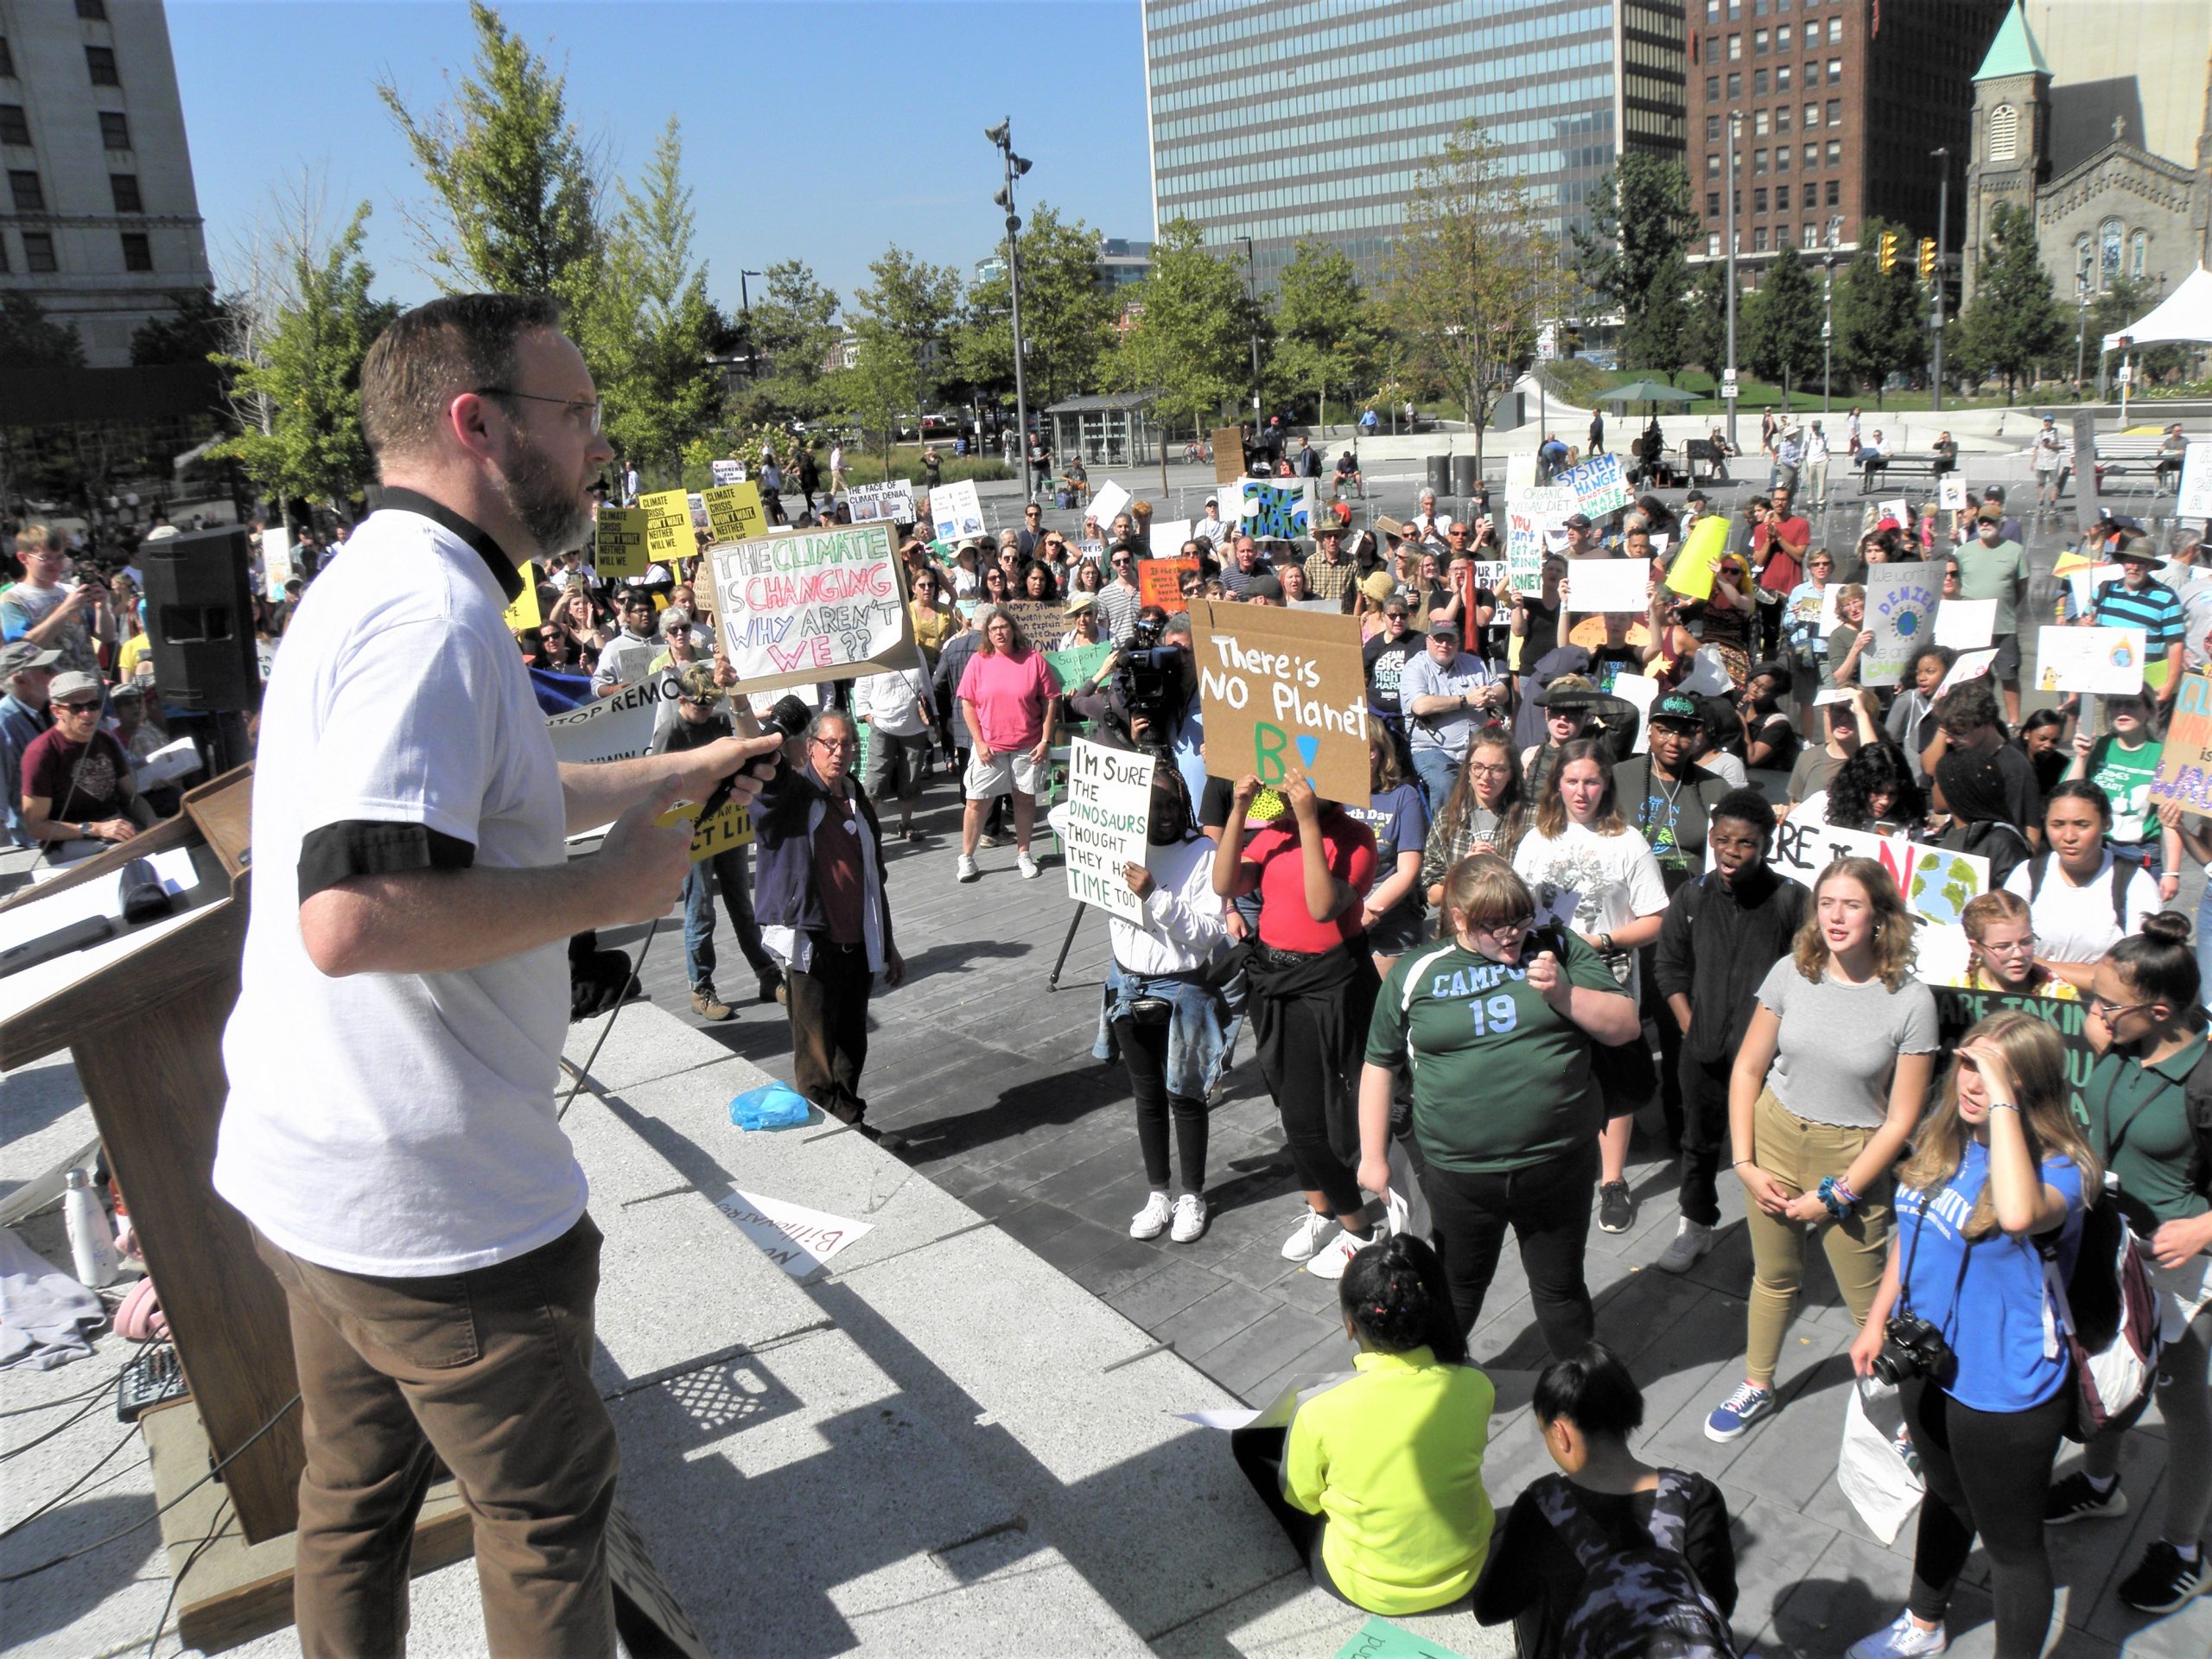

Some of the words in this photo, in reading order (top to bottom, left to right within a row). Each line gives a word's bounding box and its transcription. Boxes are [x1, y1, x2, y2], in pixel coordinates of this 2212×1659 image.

[1557, 452, 1616, 486] SYSTEM
[849, 486, 862, 495] THE
[865, 483, 884, 493] FACE
[887, 480, 897, 490] OF
[1573, 466, 1623, 497] HANGE!
[642, 496, 669, 508] CLIMATE
[706, 488, 736, 502] CLIMATE
[709, 501, 734, 513] CRISIS
[849, 493, 880, 505] CLIMATE
[881, 489, 907, 500] DENIAL
[1547, 499, 1571, 512] DIET
[1579, 487, 1623, 512] LIMATE
[600, 512, 627, 521] CLIMATE
[648, 507, 665, 518] RISIS
[600, 522, 621, 531] CRISIS
[648, 528, 674, 540] NEITHER
[716, 523, 745, 536] NEITHER
[599, 545, 626, 555] NEITHER
[650, 539, 666, 550] WILL
[713, 542, 772, 580] THE
[772, 527, 889, 571] CLIMATE
[599, 556, 618, 566] WILL
[718, 581, 746, 614] IS
[745, 563, 892, 611] CHANGING
[1878, 586, 1936, 616] DENIED
[726, 614, 794, 651] WHY
[800, 599, 900, 638] AREN'T
[767, 635, 834, 672] WE
[1058, 645, 1102, 665] Support
[1211, 635, 1291, 678] There
[1294, 656, 1320, 689] is
[1374, 658, 1406, 671] BIG
[611, 677, 681, 713] REMO
[1200, 665, 1249, 710] NO
[1271, 681, 1369, 741] Planet
[1076, 745, 1098, 777] I'M
[1103, 755, 1151, 787] SURE
[1072, 779, 1100, 803] THE
[1070, 799, 1147, 836] DINOSAURS
[1344, 808, 1365, 820] rth
[1366, 809, 1394, 825] Day
[1067, 822, 1128, 854] THOUGHT
[1068, 846, 1103, 871] THEY
[1068, 868, 1113, 908] TIME
[1114, 888, 1136, 909] TOO
[1469, 994, 1517, 1037] 19
